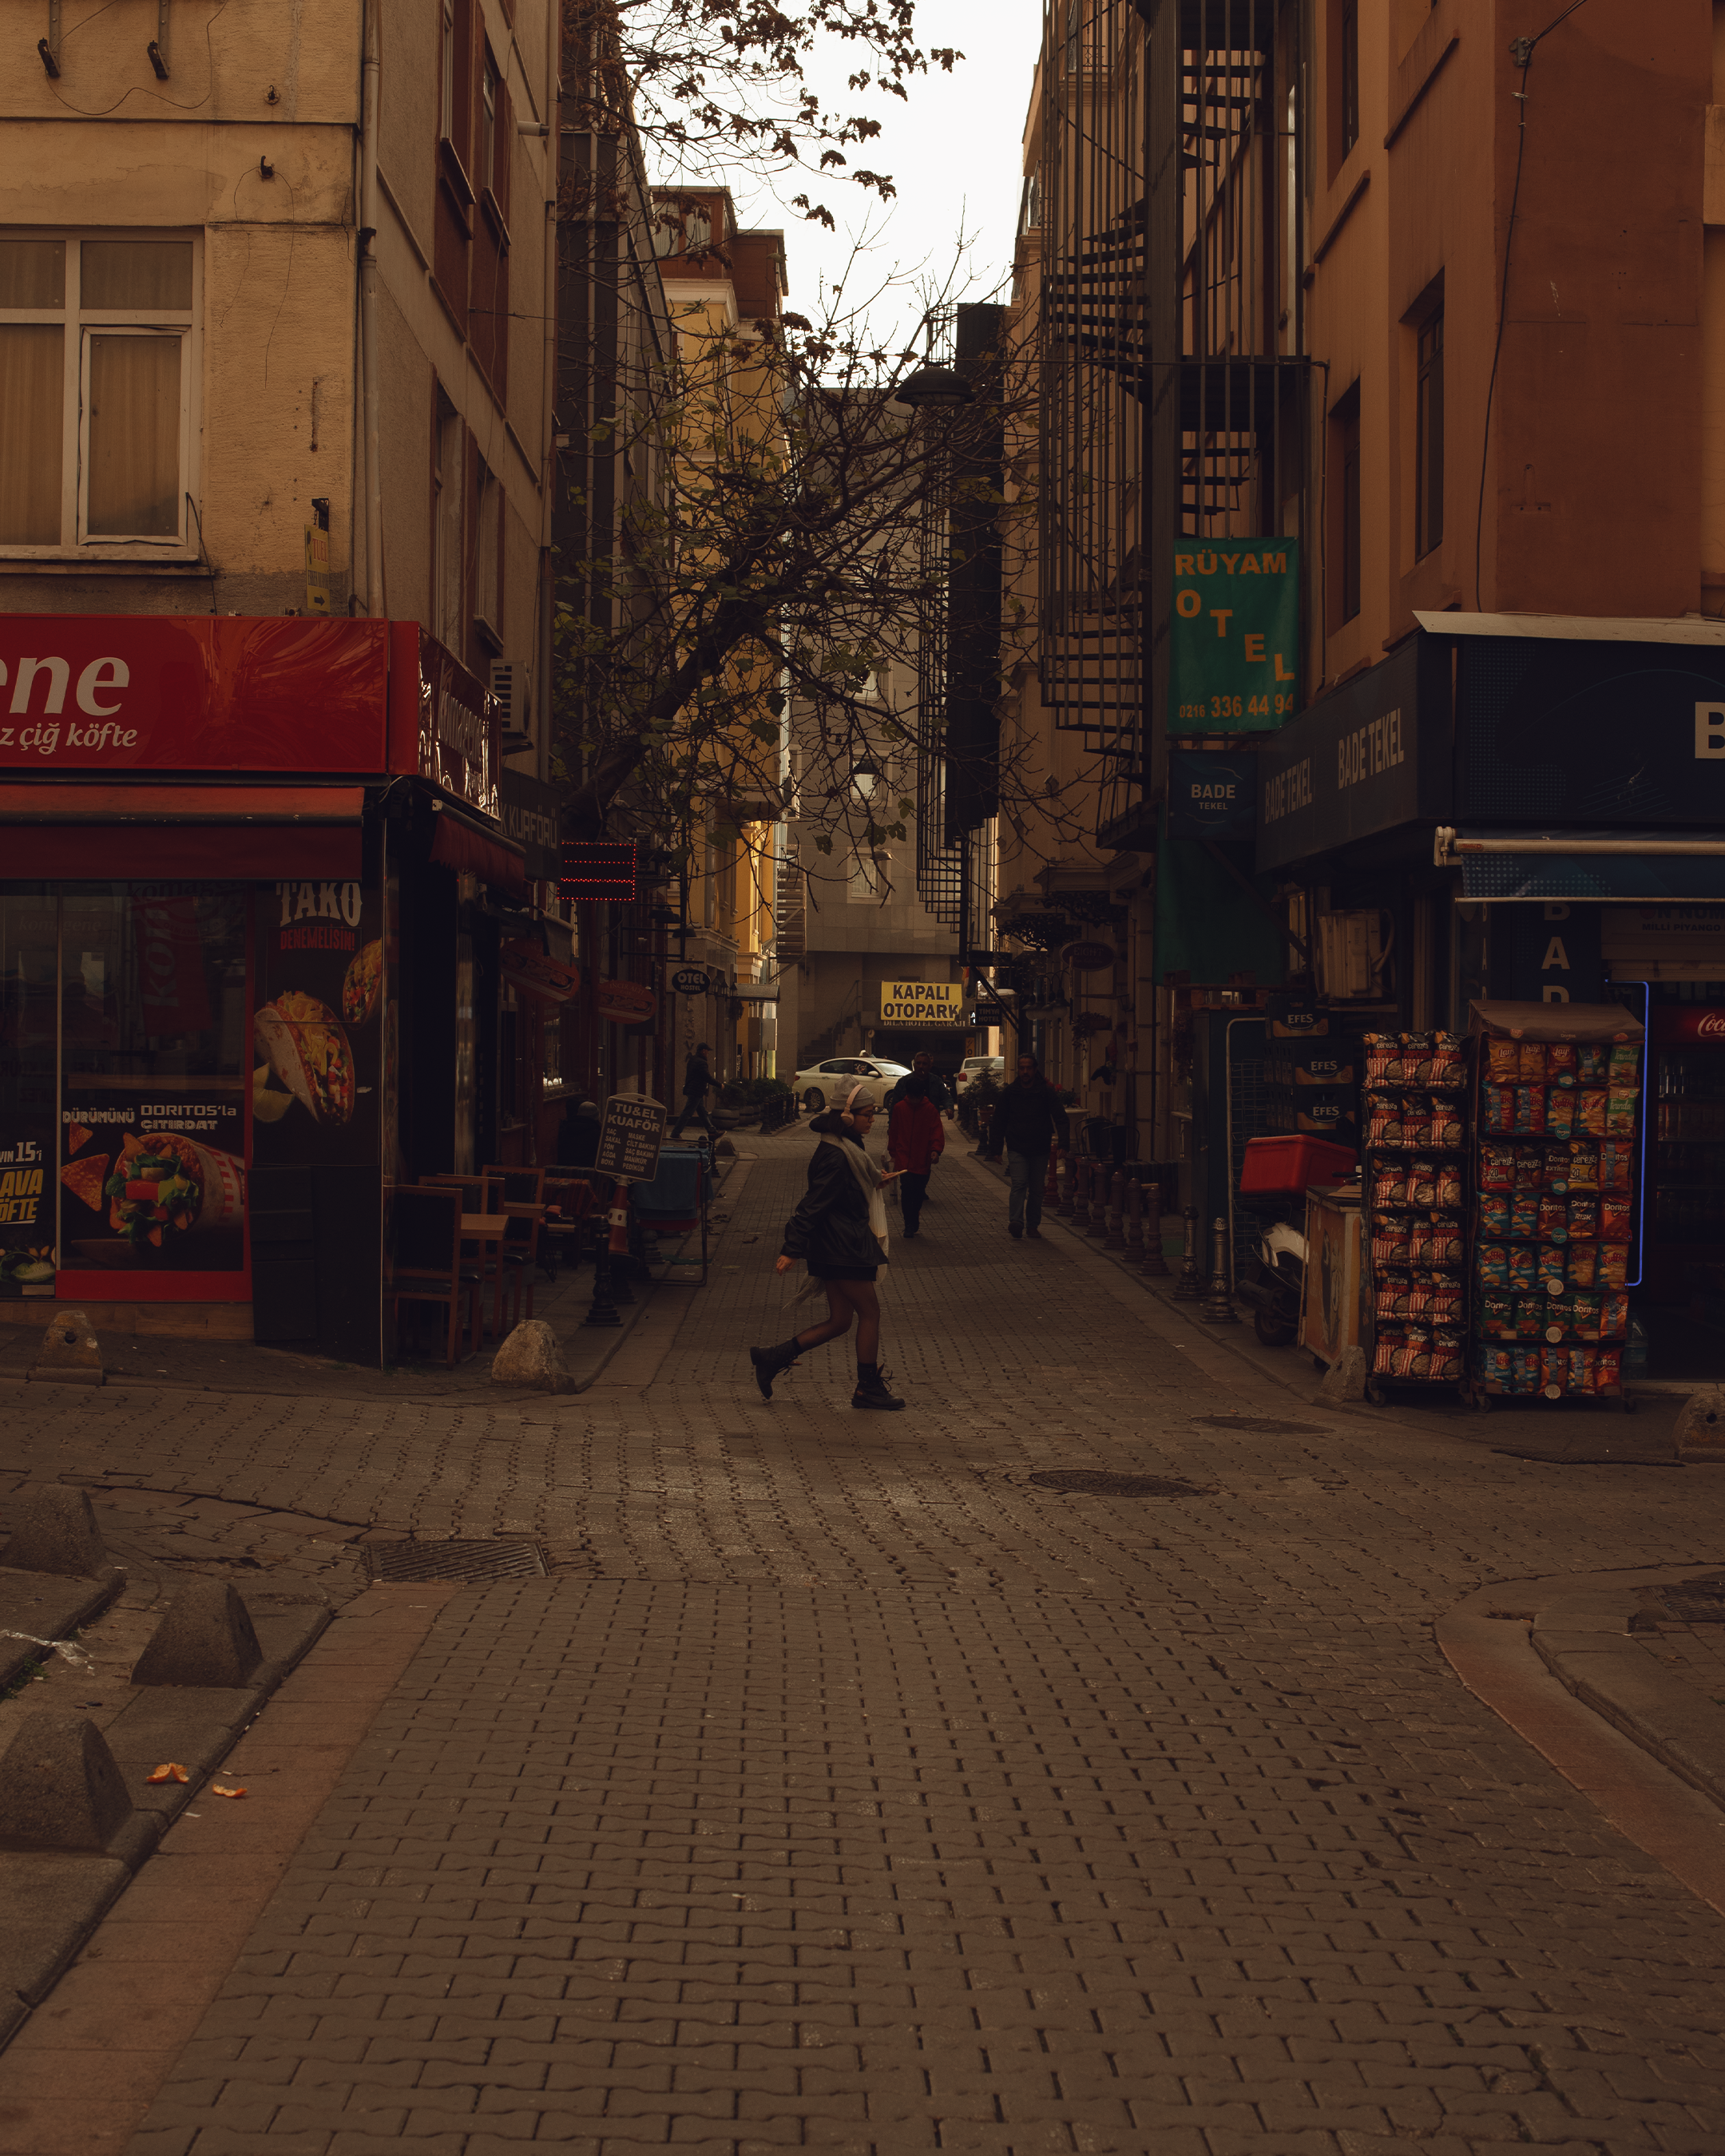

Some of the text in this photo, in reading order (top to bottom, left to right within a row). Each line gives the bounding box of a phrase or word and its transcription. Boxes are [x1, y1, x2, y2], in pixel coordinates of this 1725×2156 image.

[1175, 549, 1287, 576] RÜYAM
[1180, 693, 1294, 718] 0216 336 44 94
[19, 723, 61, 755] çiğ
[65, 722, 137, 751] köfte
[1338, 707, 1404, 791] BADE TEKEL
[1191, 783, 1235, 799] BADE
[1265, 757, 1312, 825] BADE TEKEL
[276, 882, 363, 927] TAKO
[1642, 921, 1721, 932] MİLLİ PİYANGO
[1073, 947, 1104, 957] EIGHT
[677, 972, 705, 985] OTEL
[893, 985, 950, 1001] KAPALI
[883, 1002, 958, 1019] OTOPARK
[1287, 1013, 1314, 1024] EFES
[1311, 1060, 1338, 1071] EFES
[62, 1108, 135, 1124] DÜRÜMÜNÜ
[615, 1103, 657, 1120] TU&EL
[1312, 1106, 1339, 1116] EFES
[141, 1120, 218, 1132] ÇITIRDAT
[607, 1114, 660, 1132] KUAFÖR
[628, 1132, 645, 1141] MASKE
[638, 1142, 656, 1151] BAKIMI
[624, 1155, 647, 1165] MANİKÜR
[636, 1150, 654, 1159] BAKIMI
[622, 1163, 644, 1172] PEDİKÜR
[1485, 1301, 1512, 1310] Doritos
[1517, 1301, 1542, 1310] Doritos
[1546, 1302, 1572, 1311] Doritos
[1572, 1304, 1599, 1314] Doritos
